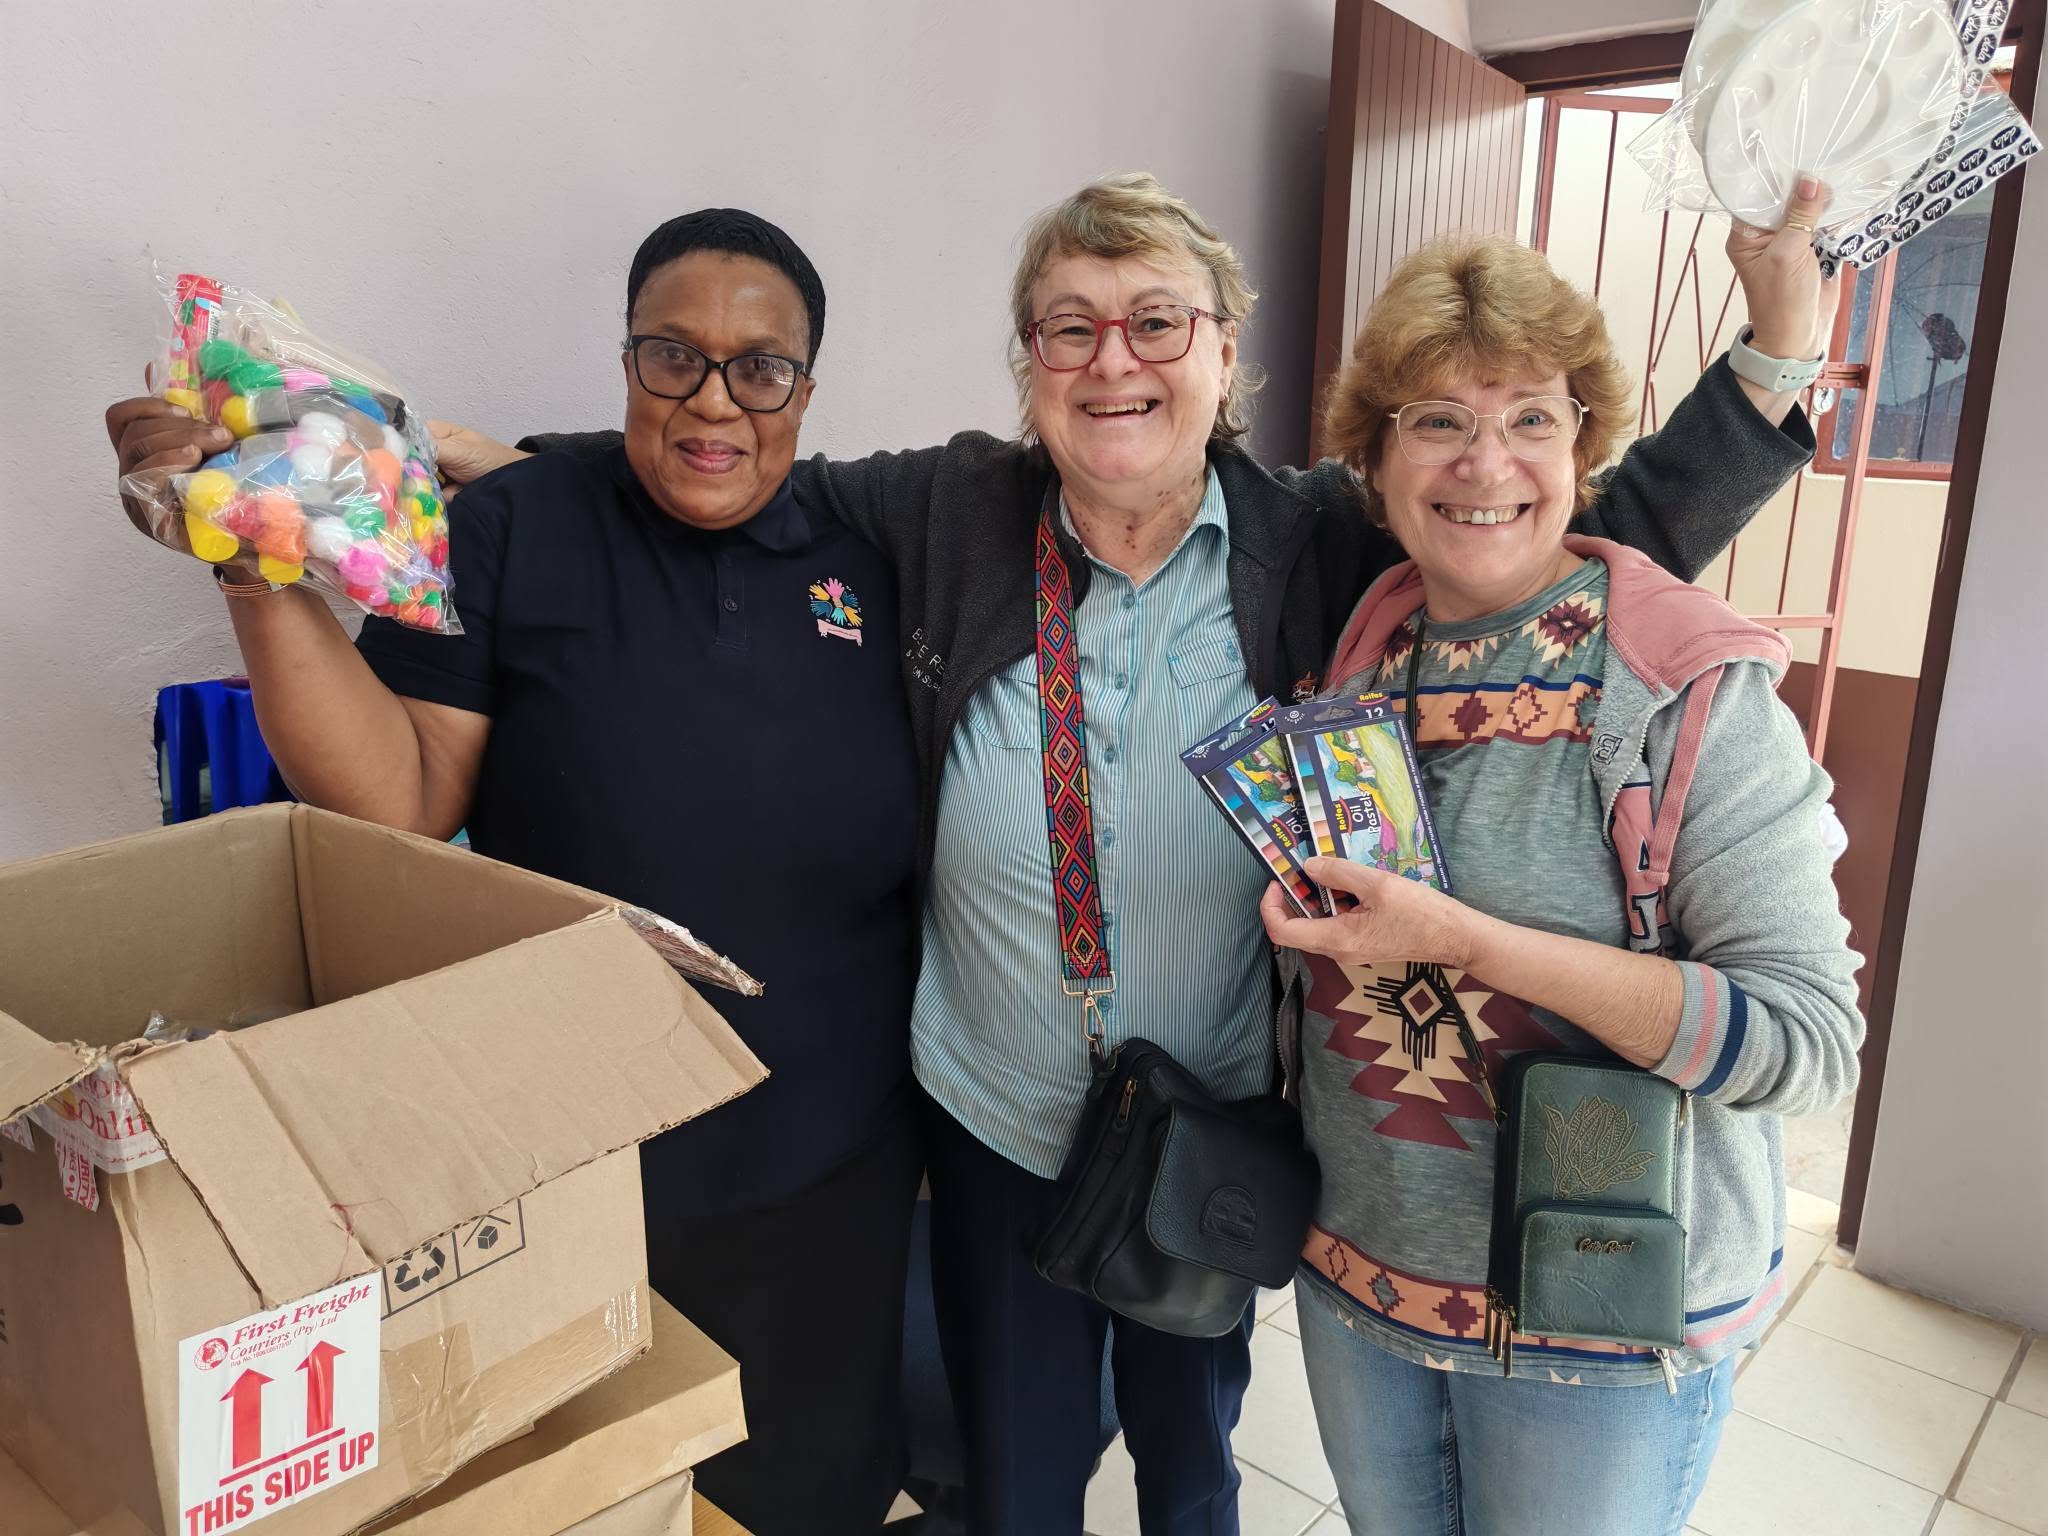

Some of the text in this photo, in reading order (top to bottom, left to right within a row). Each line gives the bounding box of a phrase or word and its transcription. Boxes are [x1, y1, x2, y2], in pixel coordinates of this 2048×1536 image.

[1978, 36, 1995, 61] dala
[1994, 126, 2017, 148] dala
[1961, 149, 1984, 170] dala
[1988, 154, 2012, 175] dala
[1929, 171, 1952, 192] dala
[1956, 176, 1979, 198] dala
[1925, 198, 1948, 219] dala
[1895, 220, 1916, 240] dala
[1864, 240, 1886, 261] dala
[1358, 692, 1383, 702] Rolfes
[1365, 707, 1384, 719] 12
[1334, 803, 1347, 831] Rolfes
[1349, 804, 1364, 823] Oil
[1359, 790, 1381, 833] Pastels
[1271, 822, 1292, 848] Rolfes
[1285, 816, 1303, 834] Oil
[232, 1284, 372, 1347] First Freight
[231, 1313, 339, 1361] Couriers (Pty) Ltd
[185, 1431, 375, 1536] THIS SIDE UP
